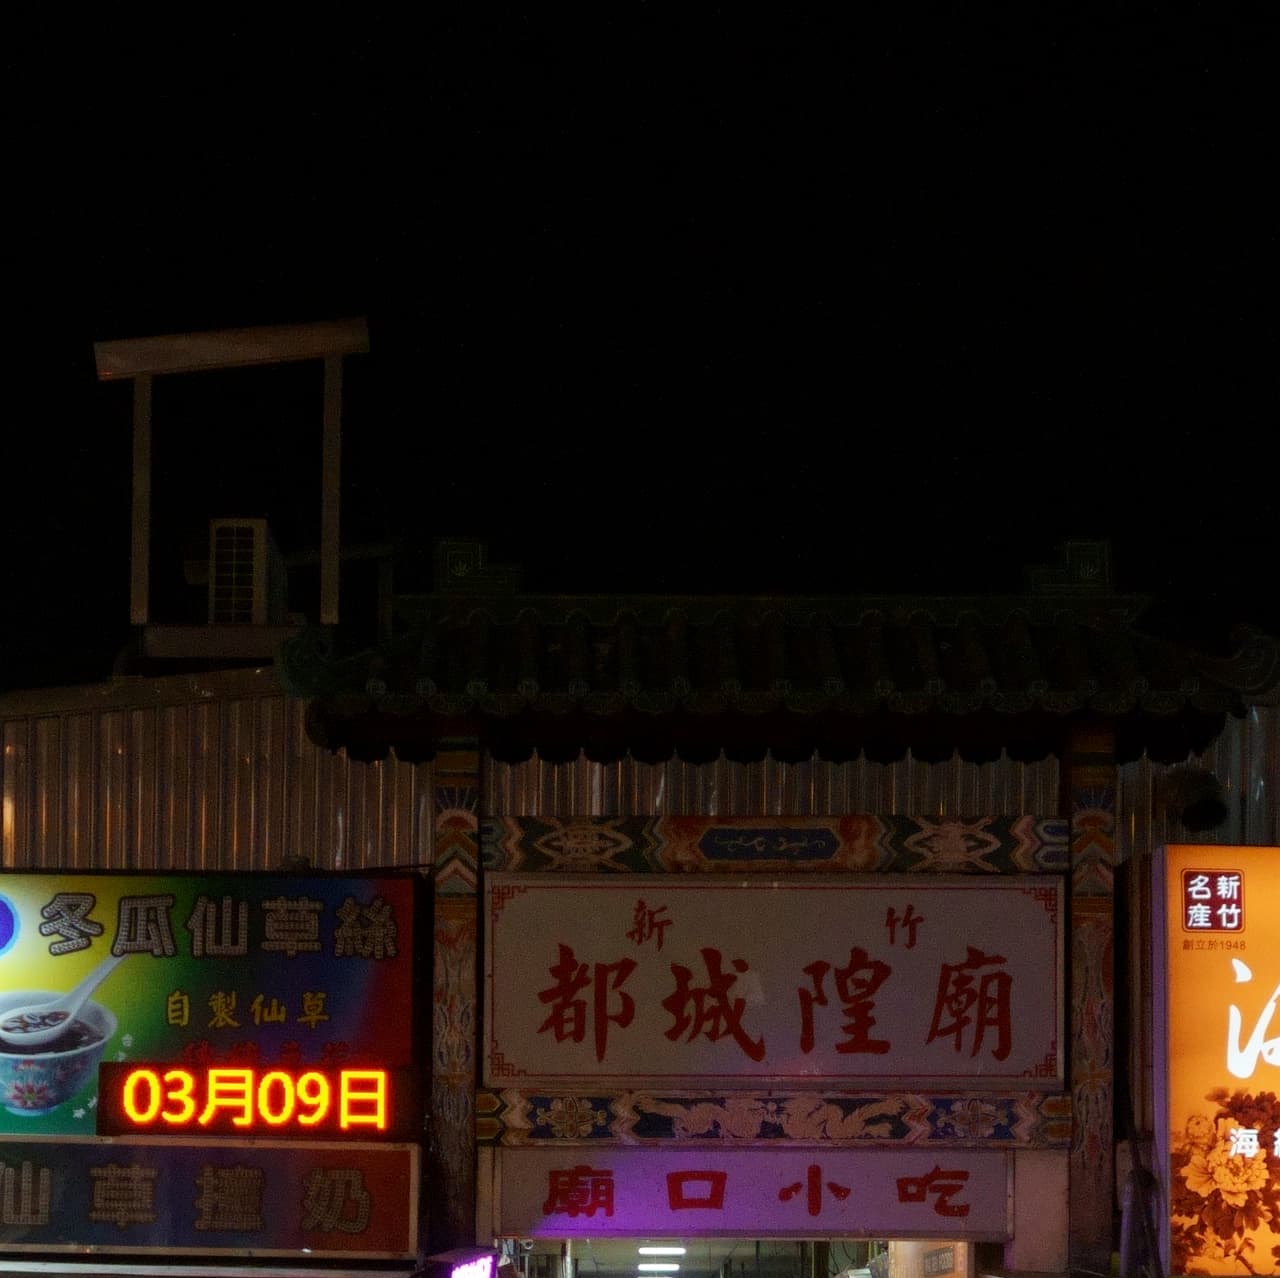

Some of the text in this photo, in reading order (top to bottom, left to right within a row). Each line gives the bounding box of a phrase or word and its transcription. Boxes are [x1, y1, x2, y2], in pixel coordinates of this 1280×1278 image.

[39, 891, 400, 960] 冬瓜仙草絲
[1187, 874, 1212, 928] 名產
[1217, 875, 1241, 929] 新竹
[166, 990, 331, 1029] 自製仙草
[537, 943, 1014, 1063] 都城隍廟
[123, 1067, 389, 1130] 03月09日
[543, 1164, 971, 1218] 廟口小吃
